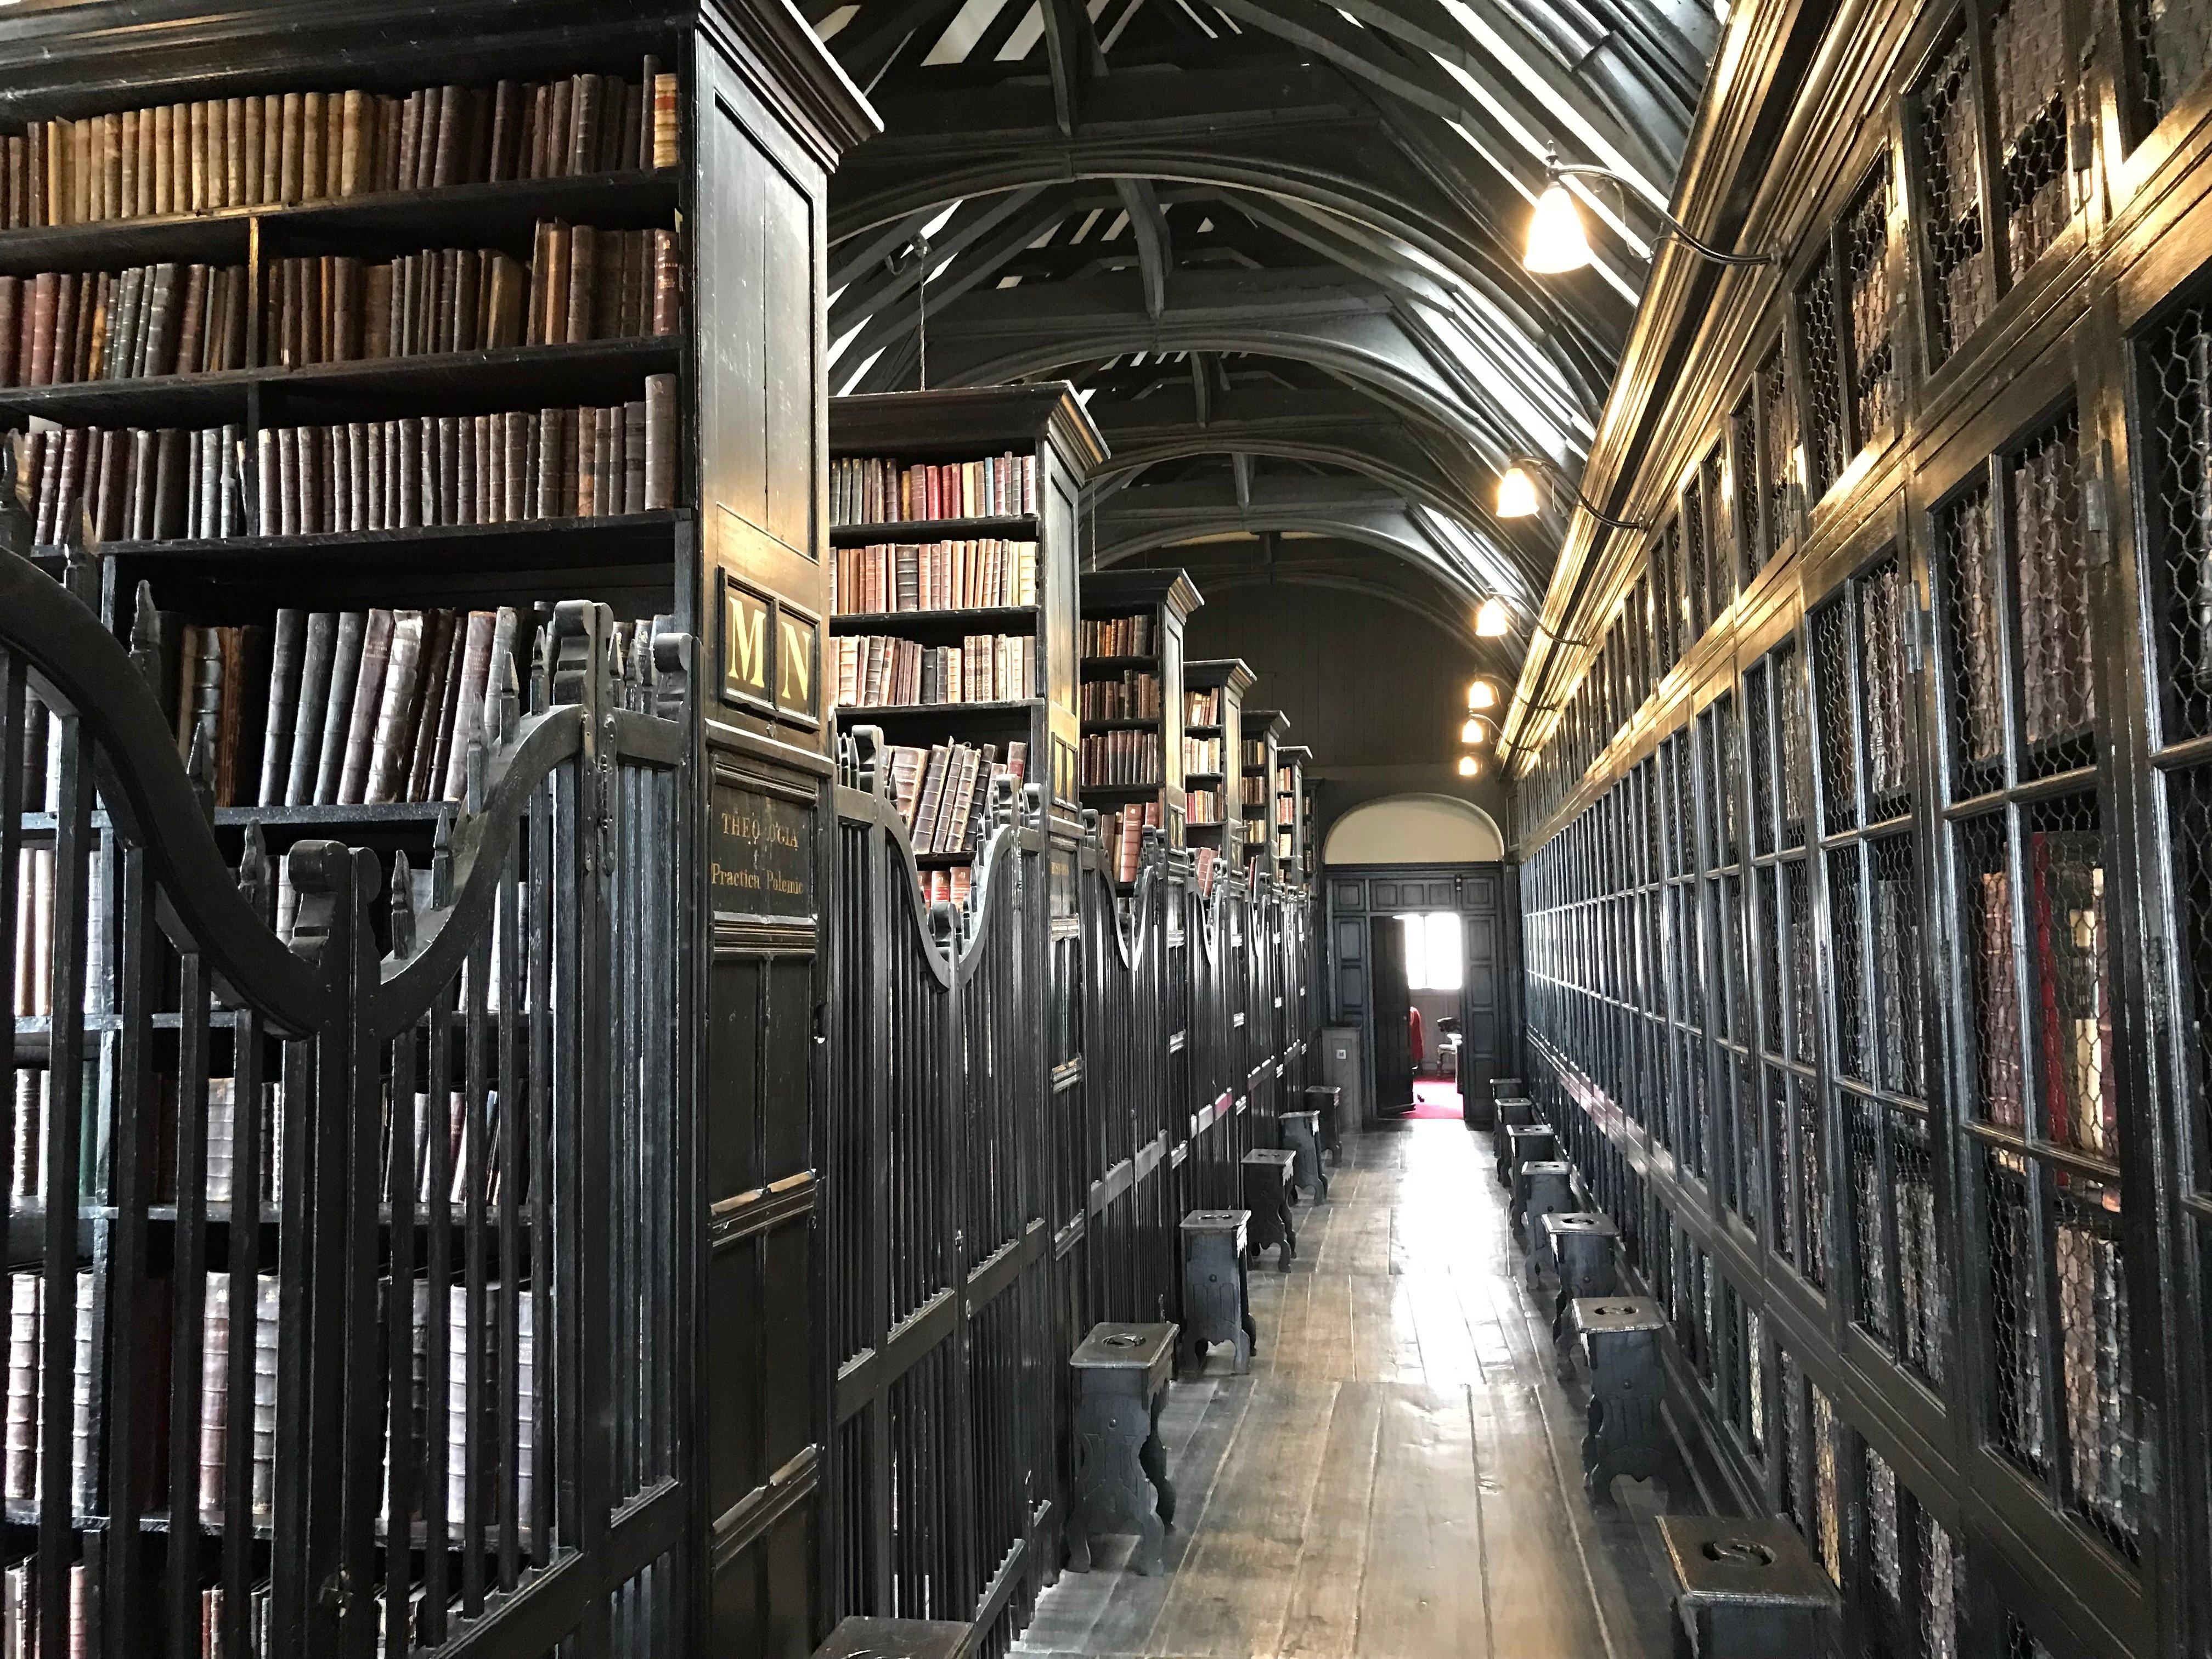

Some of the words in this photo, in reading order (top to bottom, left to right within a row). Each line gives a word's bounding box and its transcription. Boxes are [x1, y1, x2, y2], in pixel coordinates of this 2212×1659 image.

[728, 596, 766, 688] M
[781, 621, 811, 701] N
[721, 812, 799, 848] THEOOGIA
[1170, 814, 1176, 848] Q
[1178, 817, 1183, 847] R
[711, 862, 761, 890] Practica
